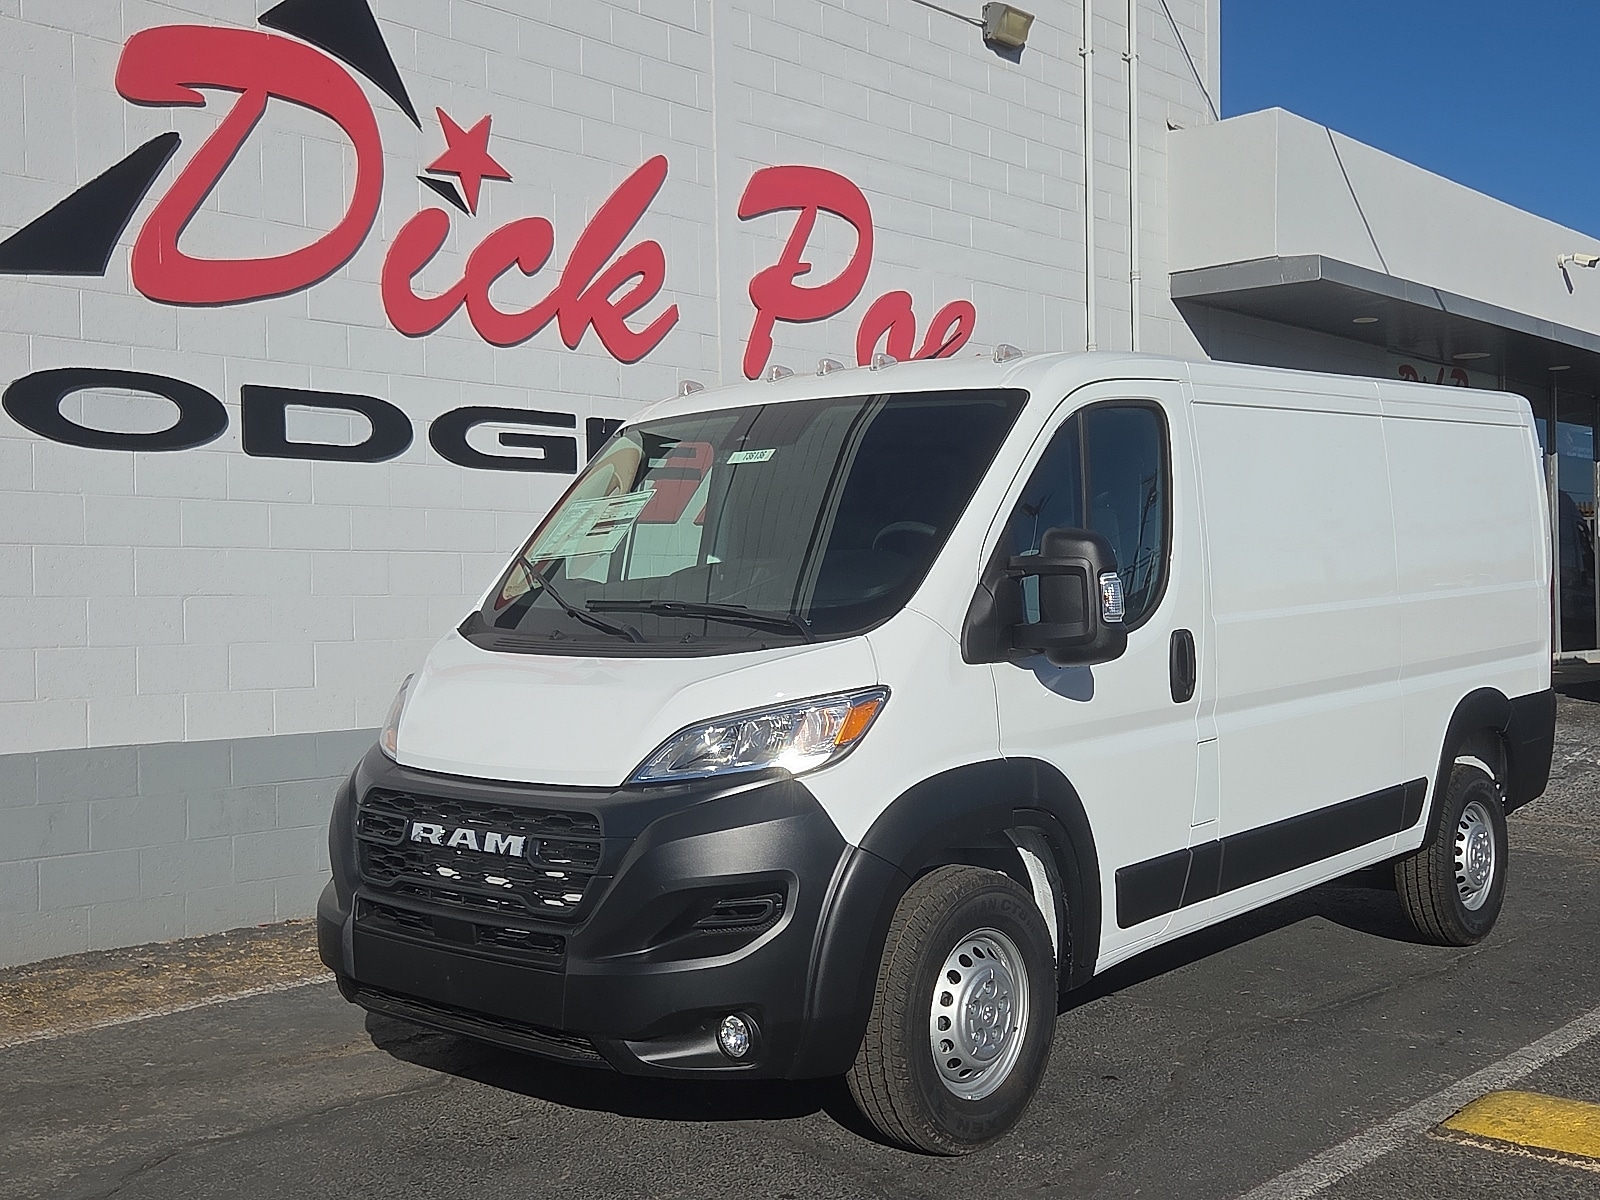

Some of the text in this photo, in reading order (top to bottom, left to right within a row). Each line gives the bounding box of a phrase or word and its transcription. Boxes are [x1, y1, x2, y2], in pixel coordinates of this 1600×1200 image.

[115, 24, 976, 381] Dick Poe
[411, 822, 526, 857] RAM
